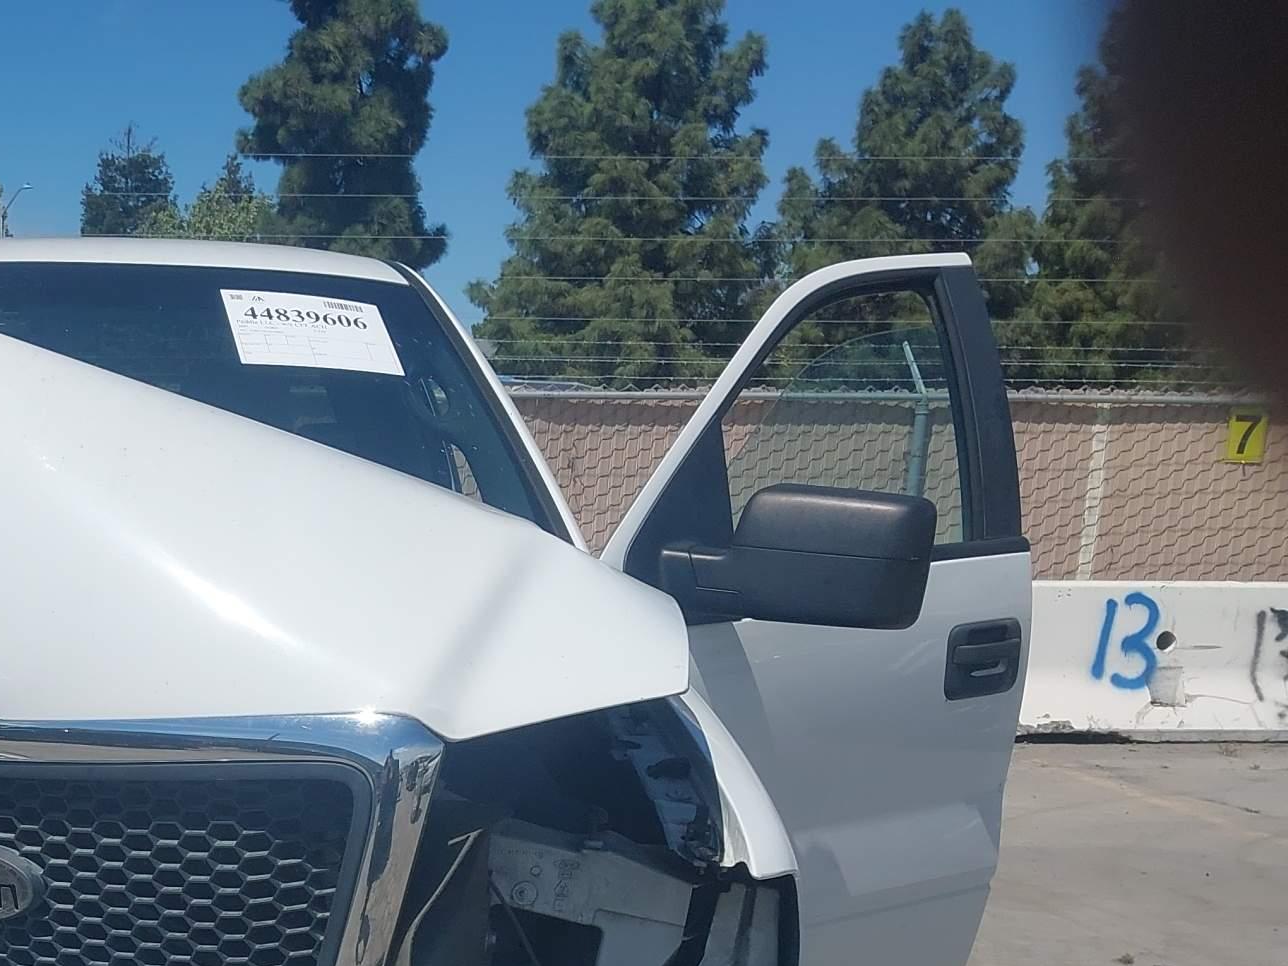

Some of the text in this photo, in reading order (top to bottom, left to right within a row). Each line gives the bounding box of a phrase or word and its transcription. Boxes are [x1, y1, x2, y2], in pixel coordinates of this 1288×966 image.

[243, 305, 368, 330] 44839606
[1234, 414, 1262, 456] 7
[1090, 591, 1161, 690] 13
